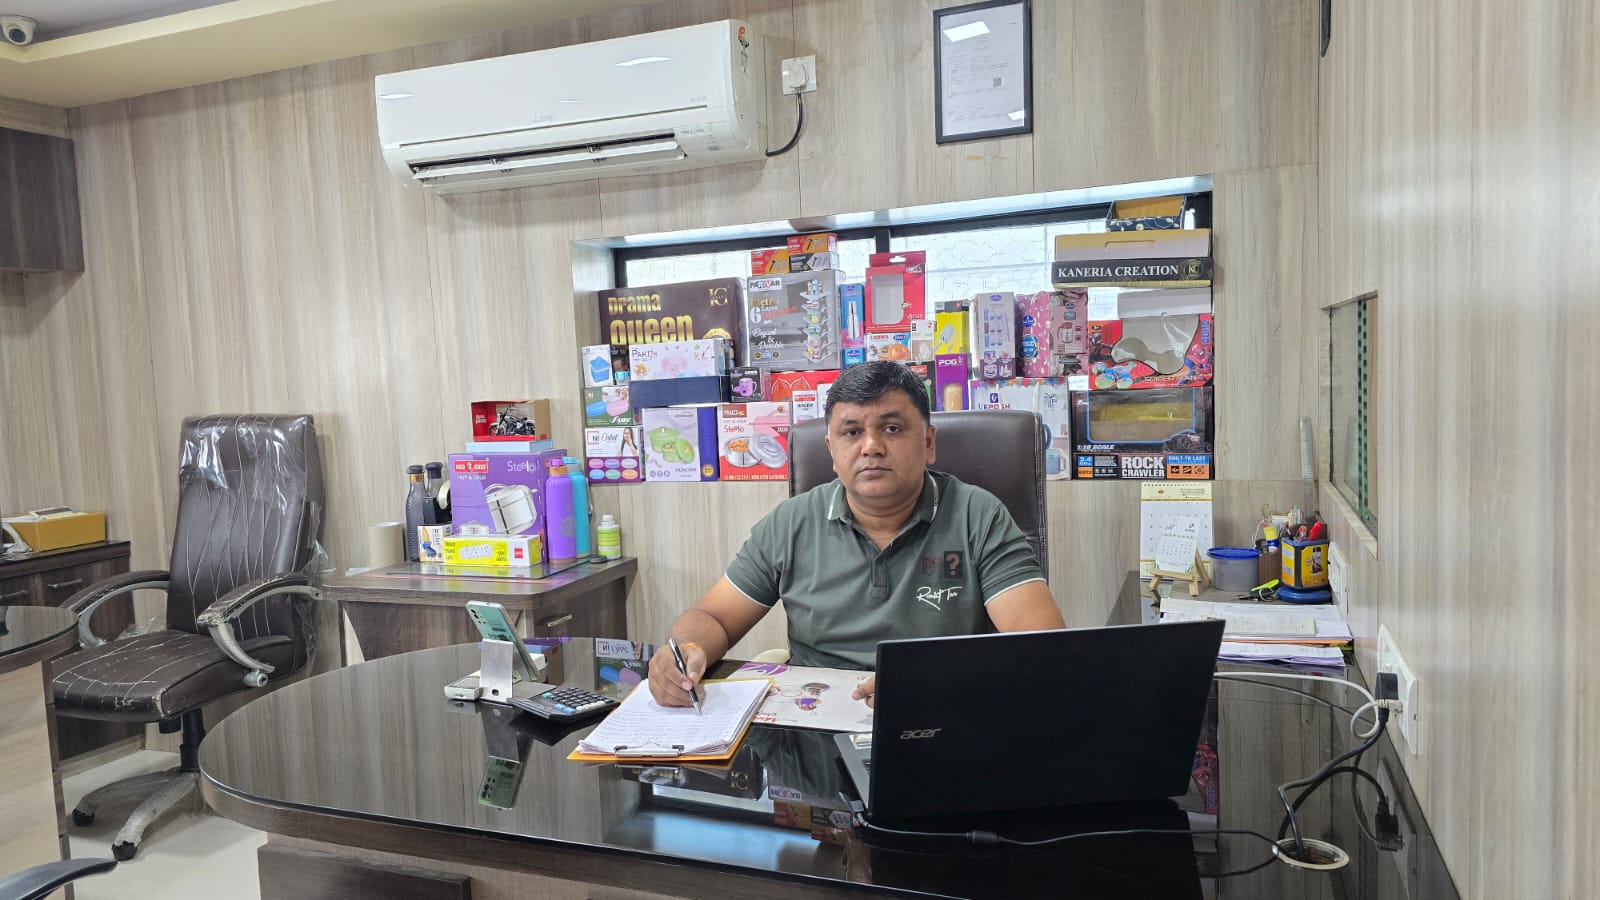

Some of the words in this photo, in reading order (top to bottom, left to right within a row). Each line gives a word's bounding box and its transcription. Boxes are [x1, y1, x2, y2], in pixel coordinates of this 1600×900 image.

[1058, 267, 1112, 278] KANERIA
[1115, 265, 1179, 277] CREATION
[608, 294, 661, 315] Drama
[750, 306, 761, 324] 6
[610, 315, 694, 345] Queen
[1121, 456, 1165, 469] ROCK
[1121, 469, 1165, 477] CRAWLER
[900, 727, 941, 739] acer
